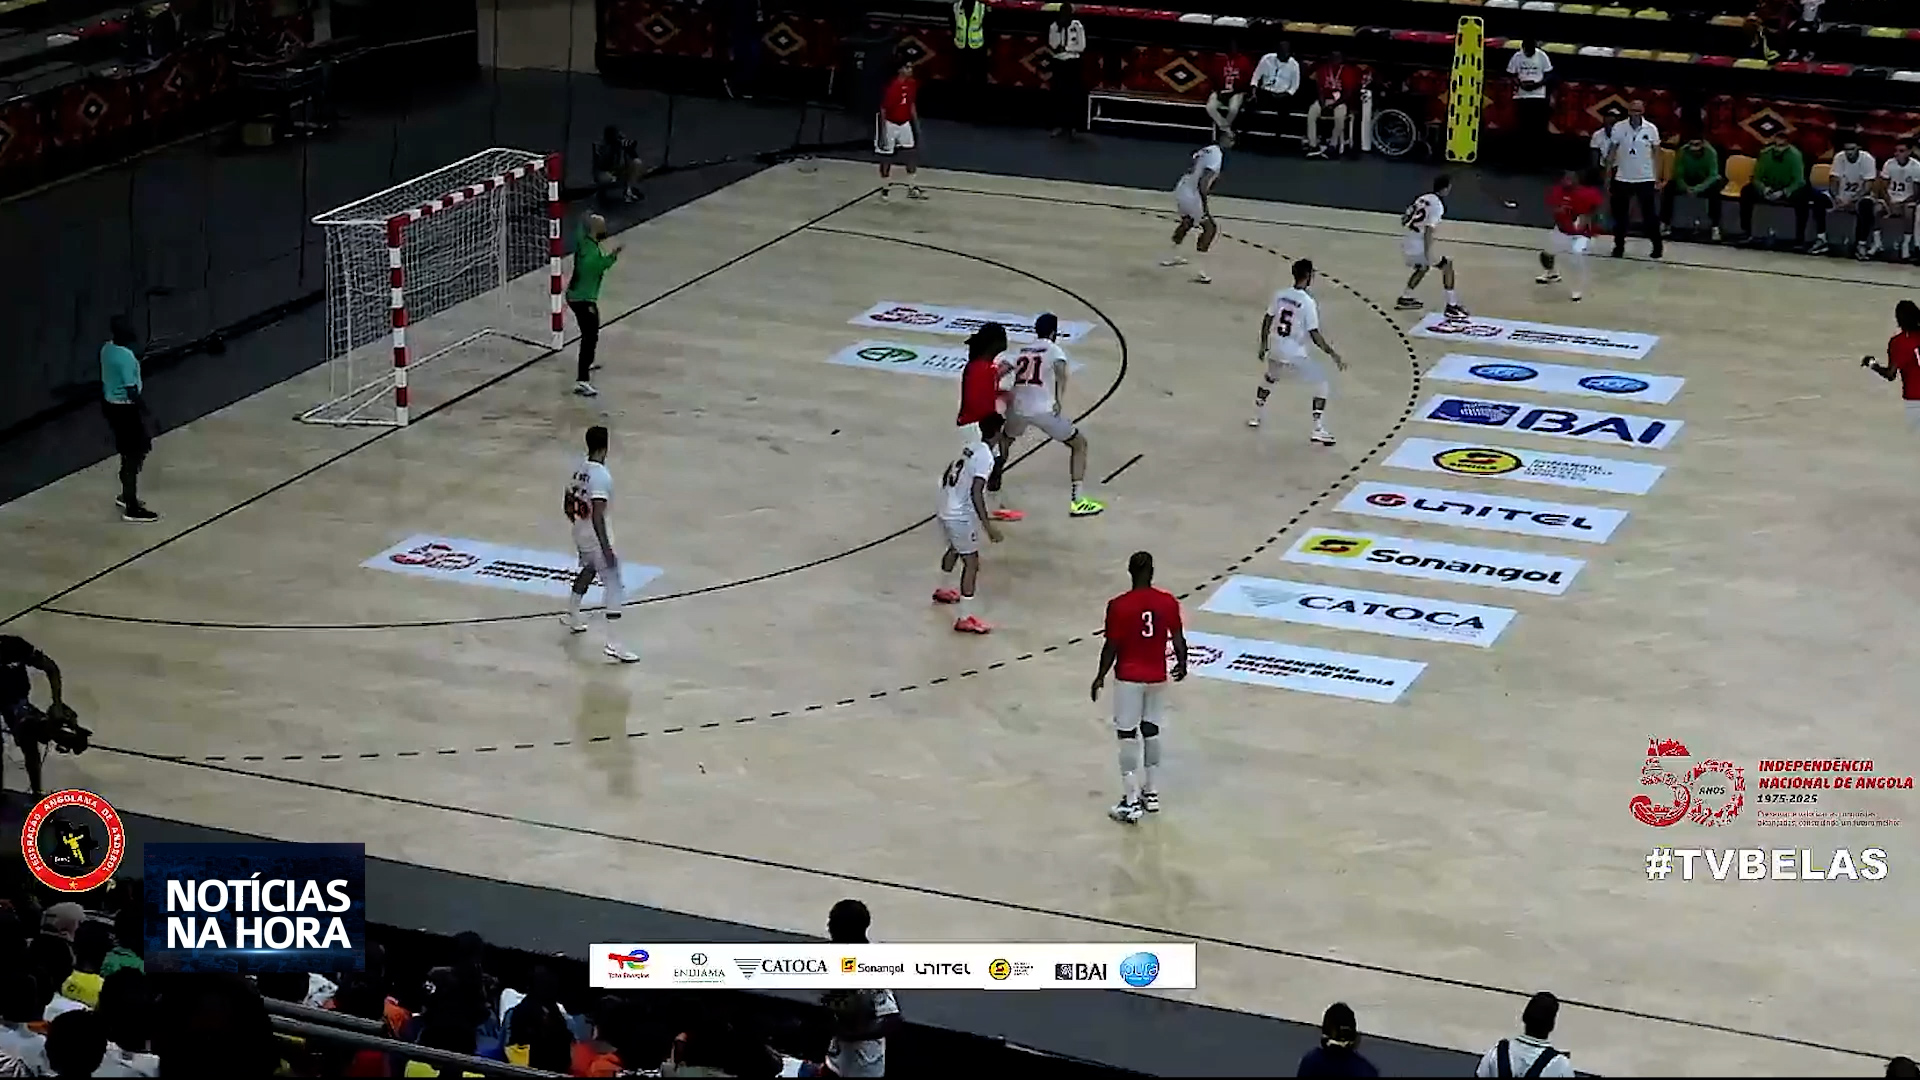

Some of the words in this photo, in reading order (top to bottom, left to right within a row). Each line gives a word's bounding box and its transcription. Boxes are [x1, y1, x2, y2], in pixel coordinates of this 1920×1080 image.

[1277, 309, 1294, 337] 5
[1014, 355, 1043, 386] 21
[1517, 409, 1666, 444] BAI
[1413, 498, 1593, 530] UNITEL
[1366, 549, 1562, 586] Sonangol
[1141, 611, 1154, 638] 3
[1299, 596, 1485, 630] CATOCA
